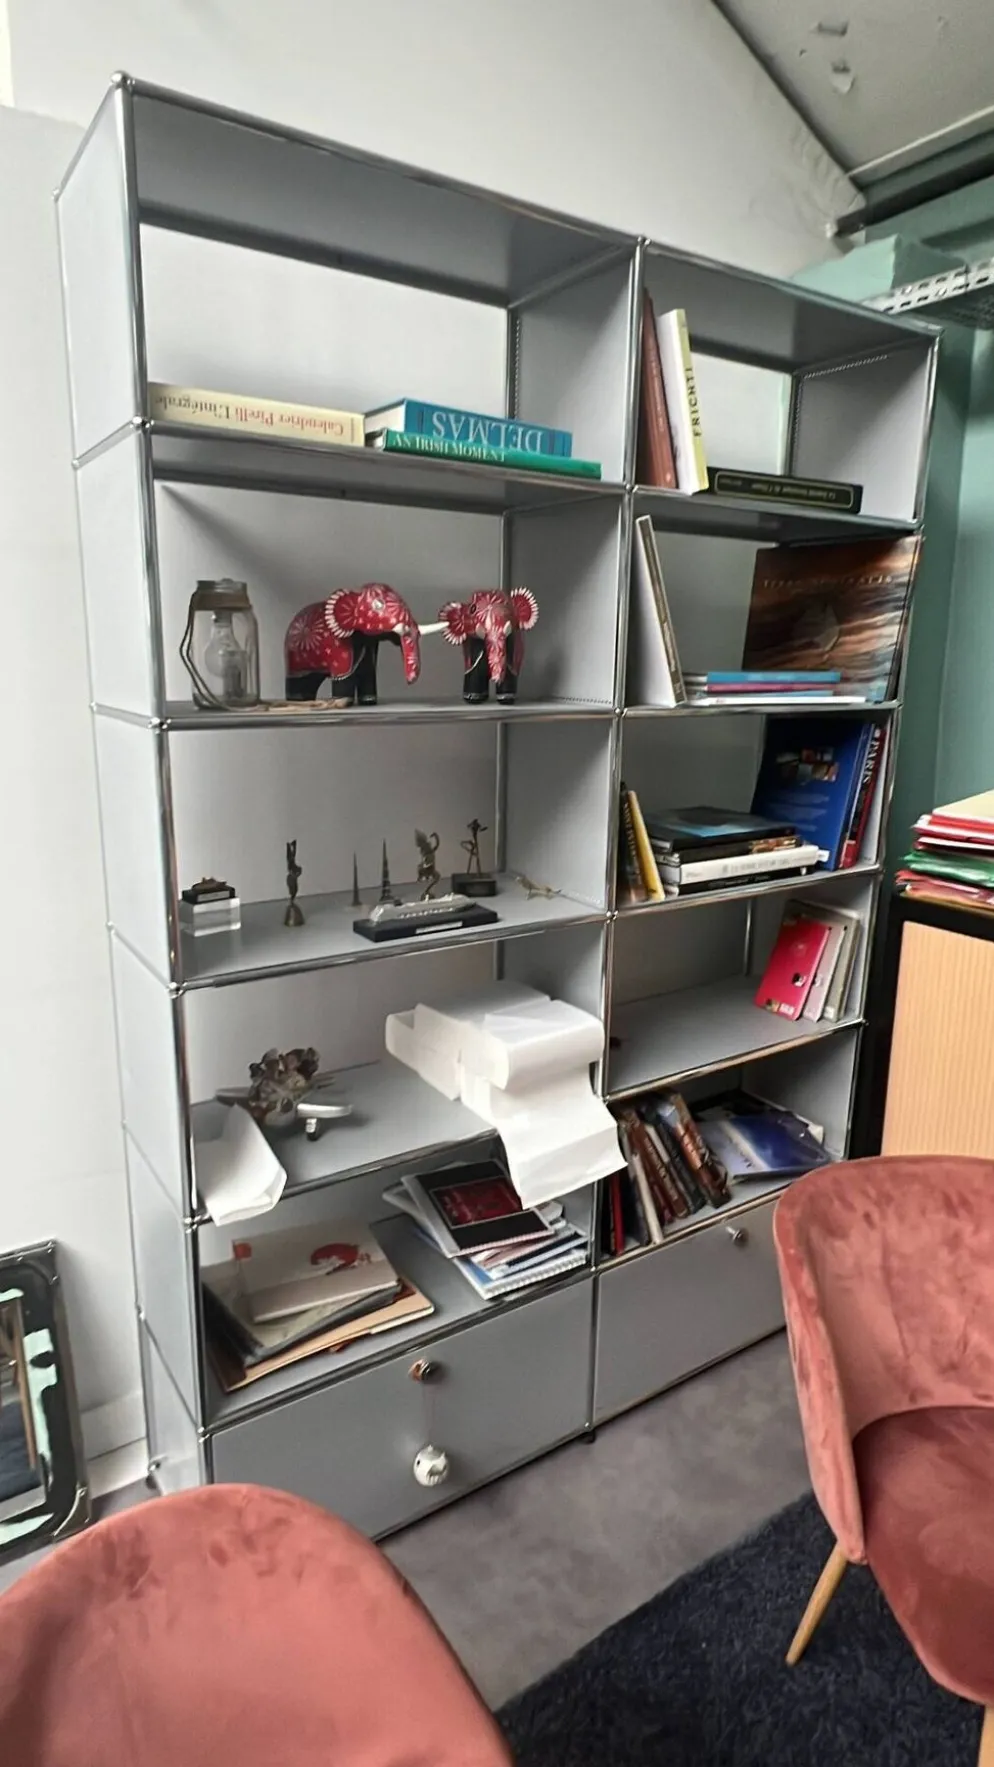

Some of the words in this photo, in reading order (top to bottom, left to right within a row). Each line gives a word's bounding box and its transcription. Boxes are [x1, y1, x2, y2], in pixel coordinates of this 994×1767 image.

[685, 367, 701, 437] FRICHTI
[235, 406, 274, 426] Pirelli
[279, 414, 344, 436] Calendrier
[432, 411, 544, 455] DELMAS
[453, 440, 506, 463] MOMENT
